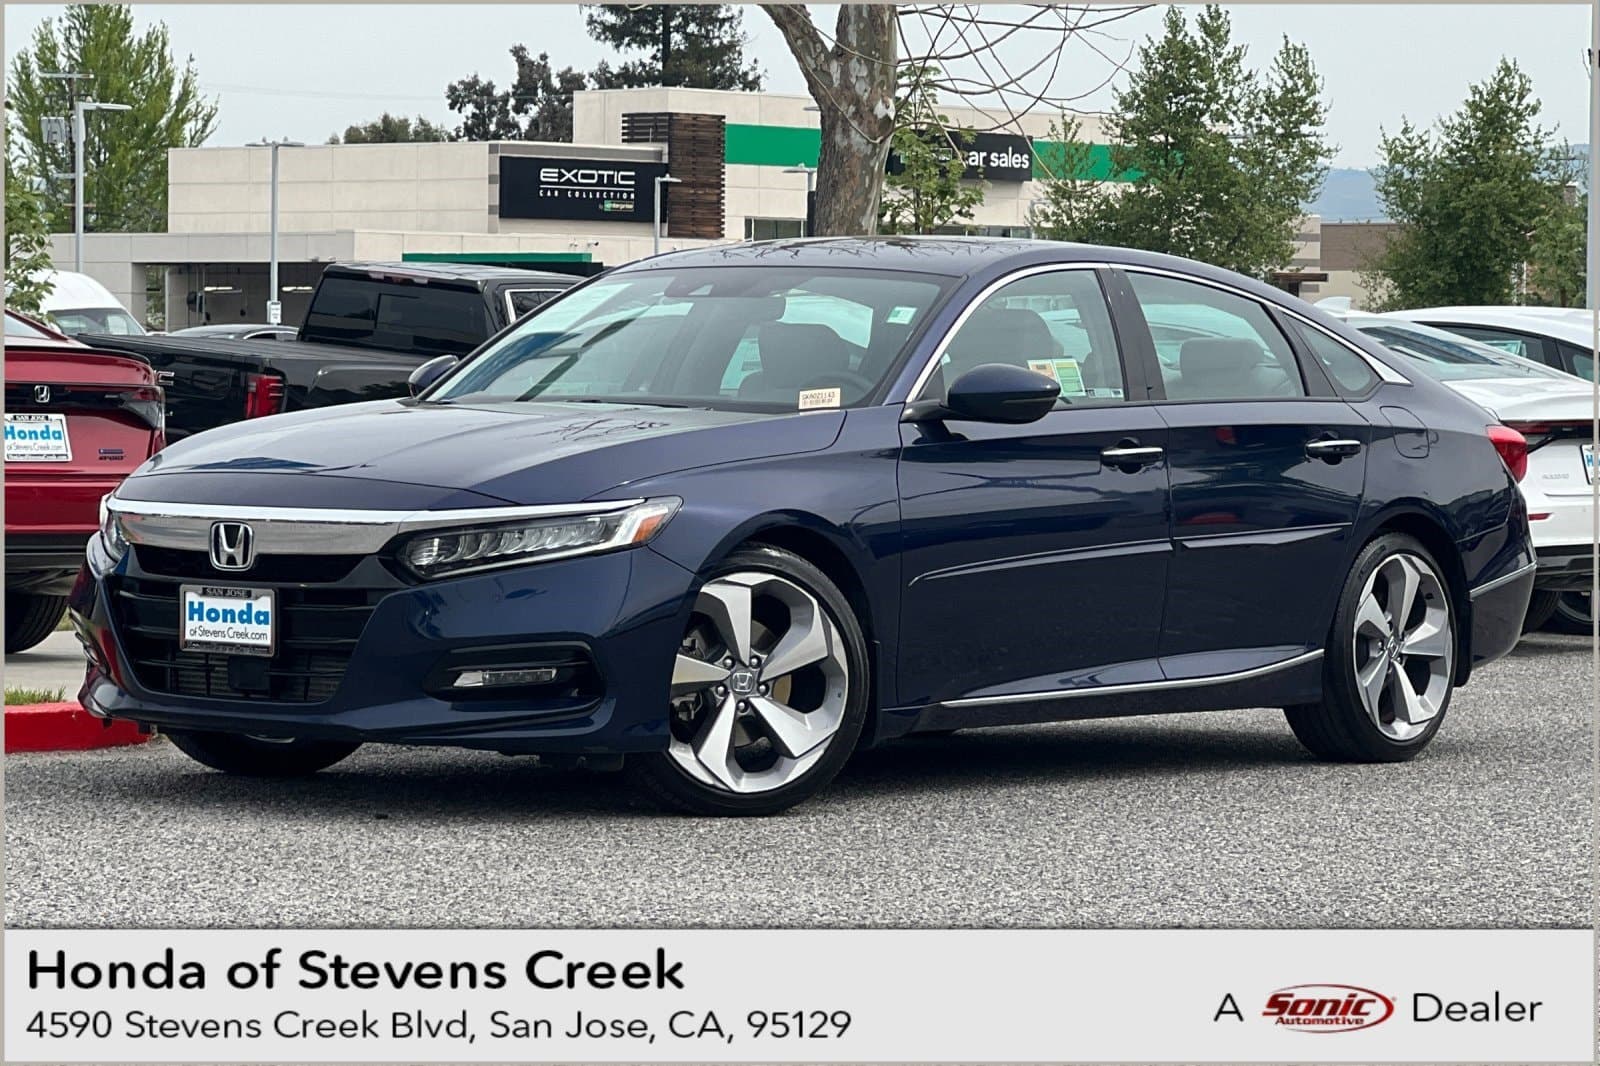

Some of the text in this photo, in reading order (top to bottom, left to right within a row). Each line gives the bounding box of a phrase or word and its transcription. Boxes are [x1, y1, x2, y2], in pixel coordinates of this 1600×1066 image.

[966, 151, 987, 166] ar
[990, 146, 1029, 168] sales
[540, 168, 635, 185] EXOTIC
[539, 189, 635, 199] CAR COLLECTION
[4, 425, 63, 440] Honda
[188, 601, 270, 625] Honda
